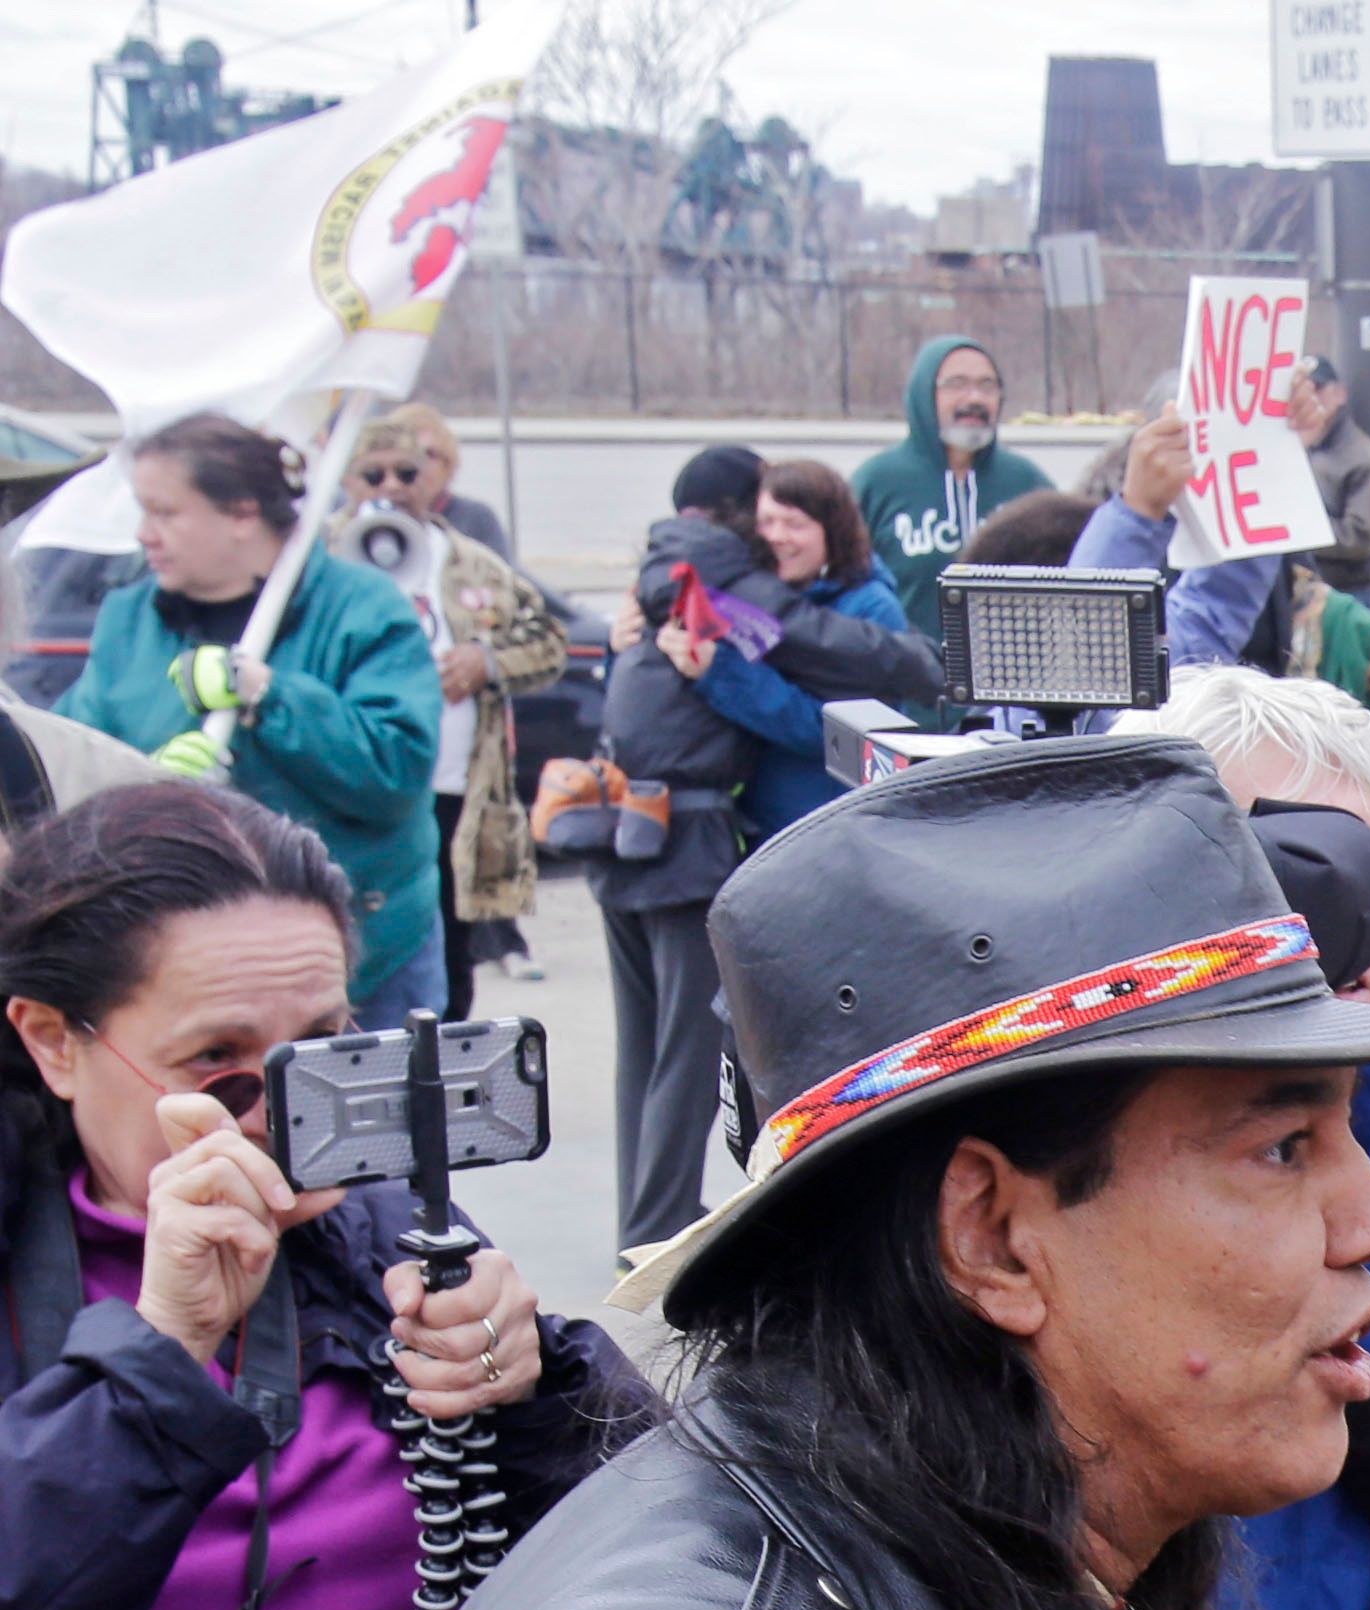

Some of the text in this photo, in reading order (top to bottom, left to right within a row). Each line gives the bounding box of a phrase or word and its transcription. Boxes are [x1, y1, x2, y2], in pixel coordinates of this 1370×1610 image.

[1290, 1, 1364, 38] CHANGE
[1297, 48, 1359, 84] LANES
[1293, 94, 1369, 129] TO PASS
